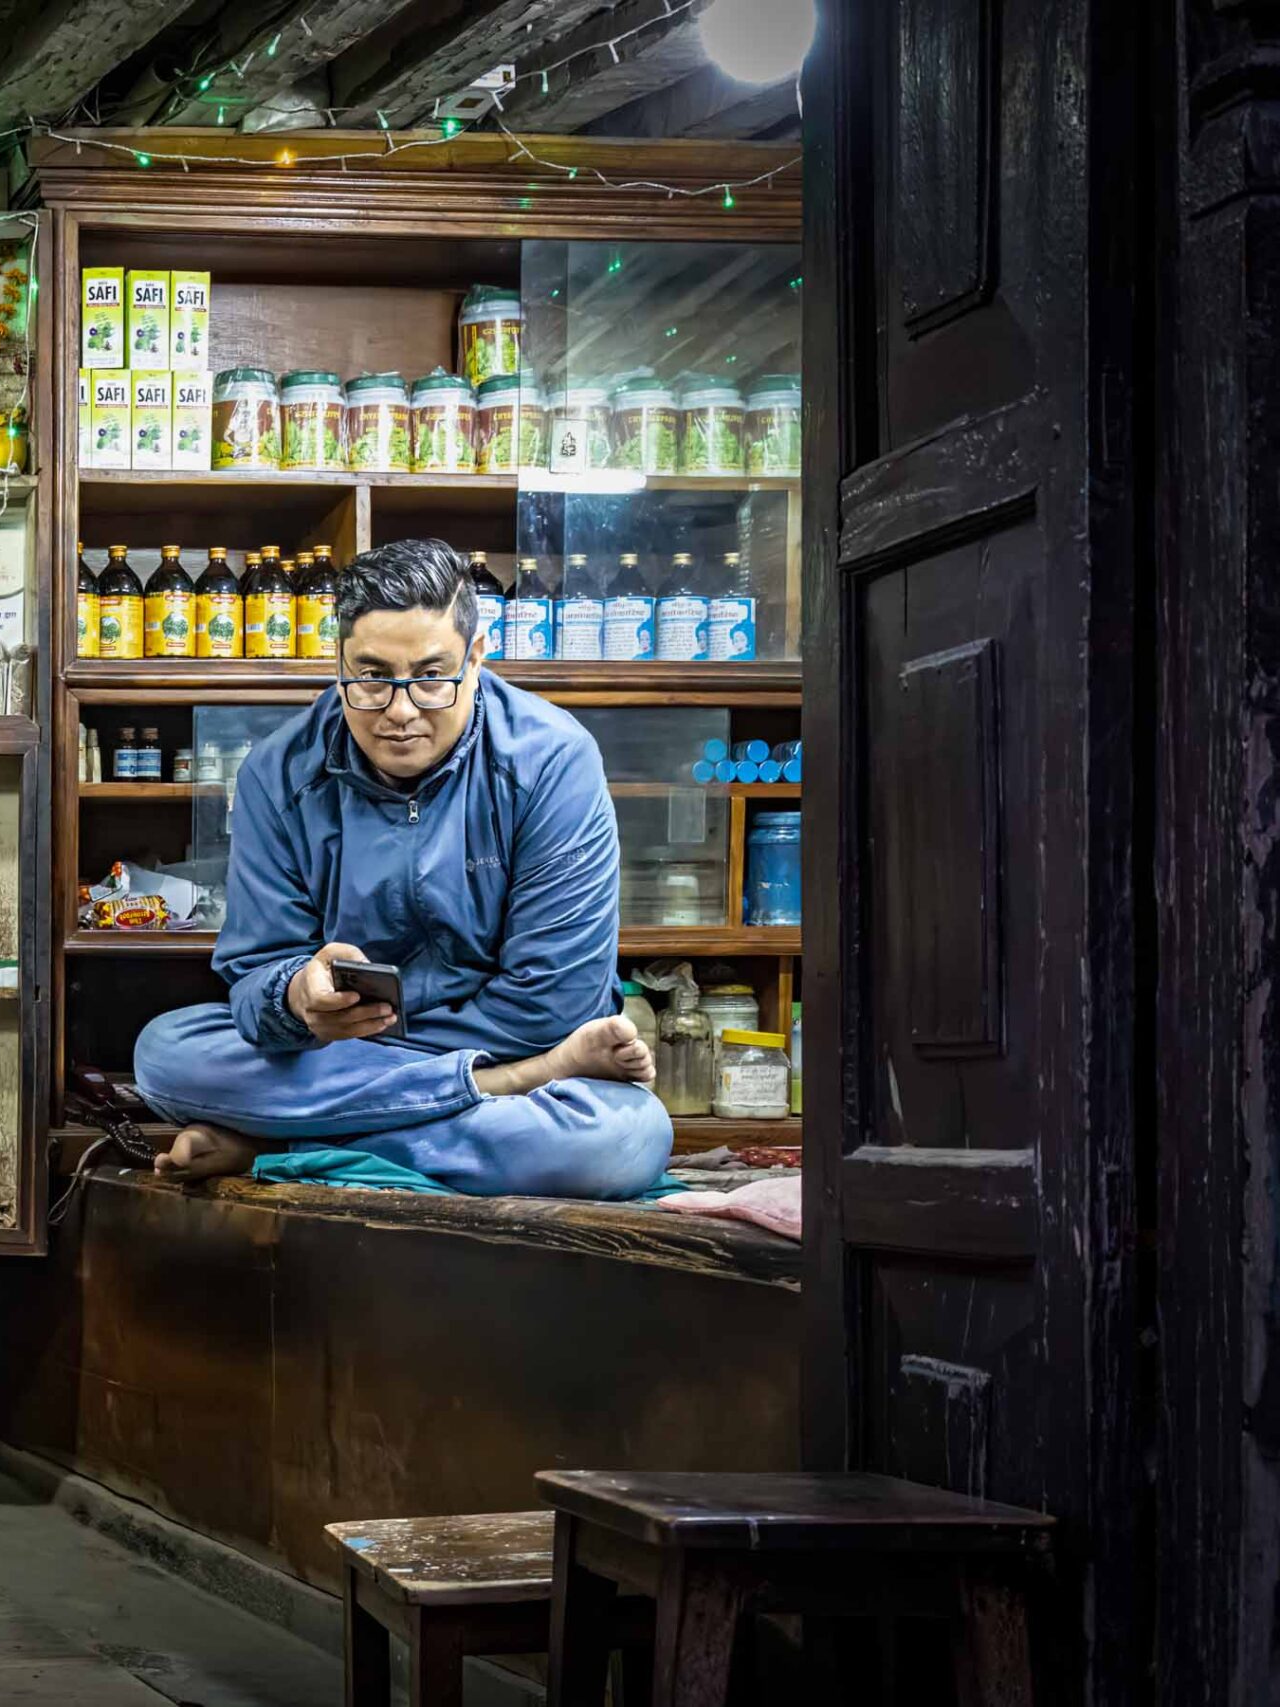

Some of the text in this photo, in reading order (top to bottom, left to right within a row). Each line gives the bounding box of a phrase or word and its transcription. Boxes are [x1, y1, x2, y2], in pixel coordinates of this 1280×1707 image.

[88, 286, 117, 301] SAFI
[135, 287, 163, 303] SAFI
[177, 290, 204, 306] SAFI
[97, 387, 125, 402] SAFI
[137, 388, 165, 403] SAFI
[179, 388, 206, 403] SAFI
